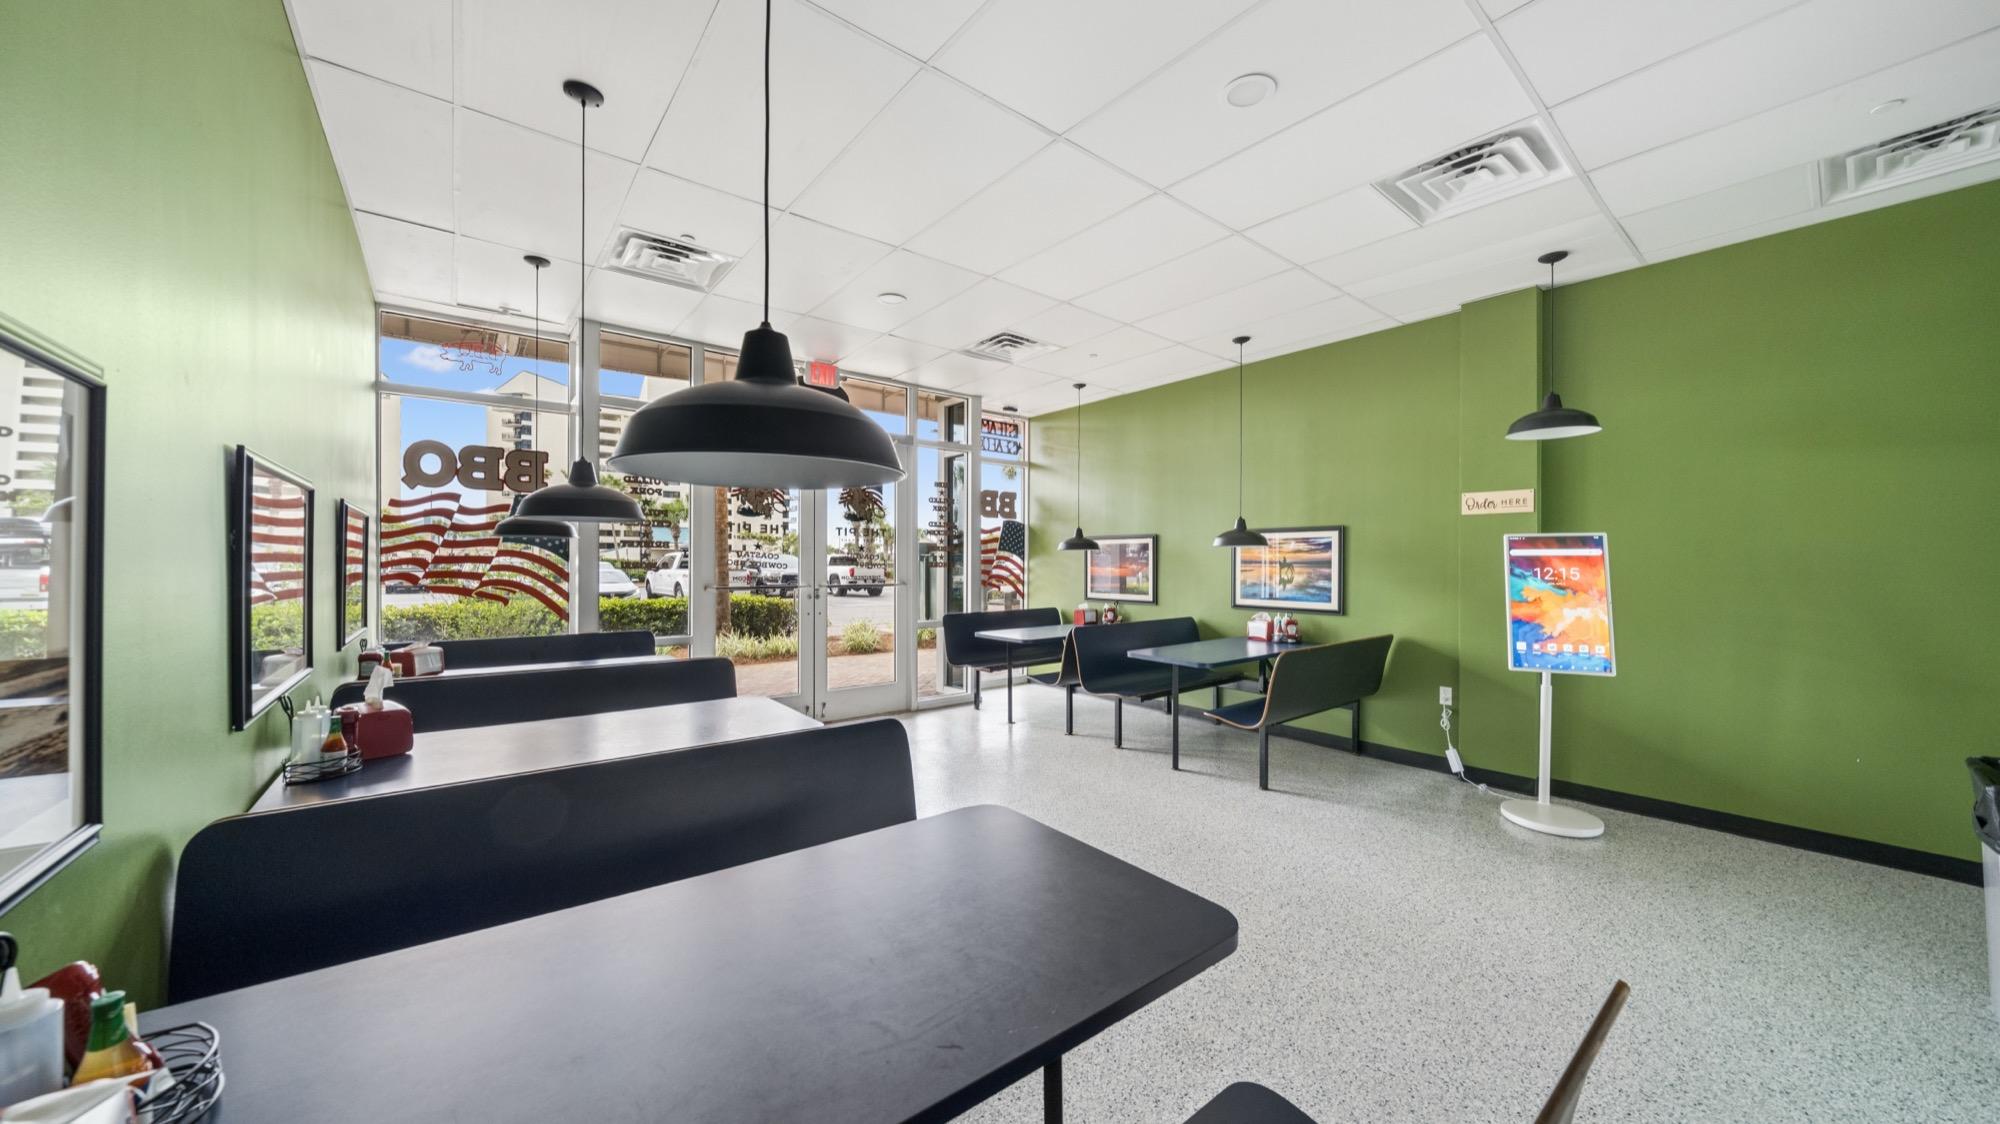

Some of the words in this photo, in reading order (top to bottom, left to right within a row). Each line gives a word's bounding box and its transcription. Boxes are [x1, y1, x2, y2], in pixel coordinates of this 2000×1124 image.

[811, 362, 835, 386] EXIT
[1465, 497, 1497, 511] Order
[1534, 567, 1580, 581] 12:15
